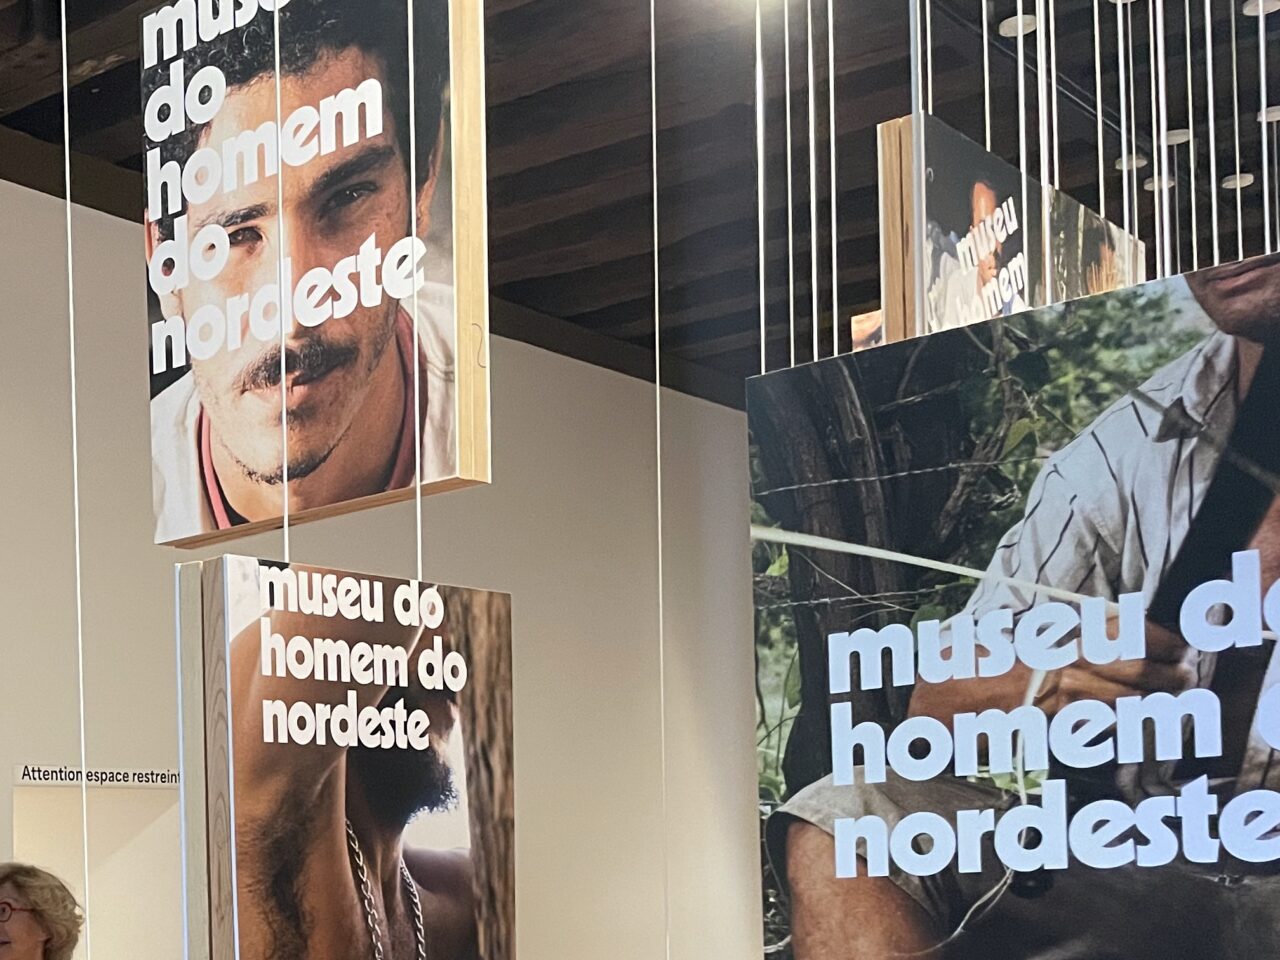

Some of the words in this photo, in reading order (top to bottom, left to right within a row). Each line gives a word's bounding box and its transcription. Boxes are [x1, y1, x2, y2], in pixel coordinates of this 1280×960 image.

[143, 0, 292, 69] mus
[144, 58, 226, 142] do
[147, 78, 383, 222] homem
[149, 214, 231, 295] do
[956, 196, 1019, 276] museu
[152, 232, 427, 375] nordeste
[259, 565, 384, 622] museu
[394, 579, 445, 629] do
[828, 591, 1146, 694] museu
[1180, 549, 1280, 652] d
[260, 616, 409, 688] homem
[418, 636, 468, 692] do
[262, 690, 430, 750] nordeste
[830, 688, 1222, 786] homem
[22, 765, 83, 782] Attention
[86, 769, 130, 786] espace
[834, 774, 1280, 878] nordeste
